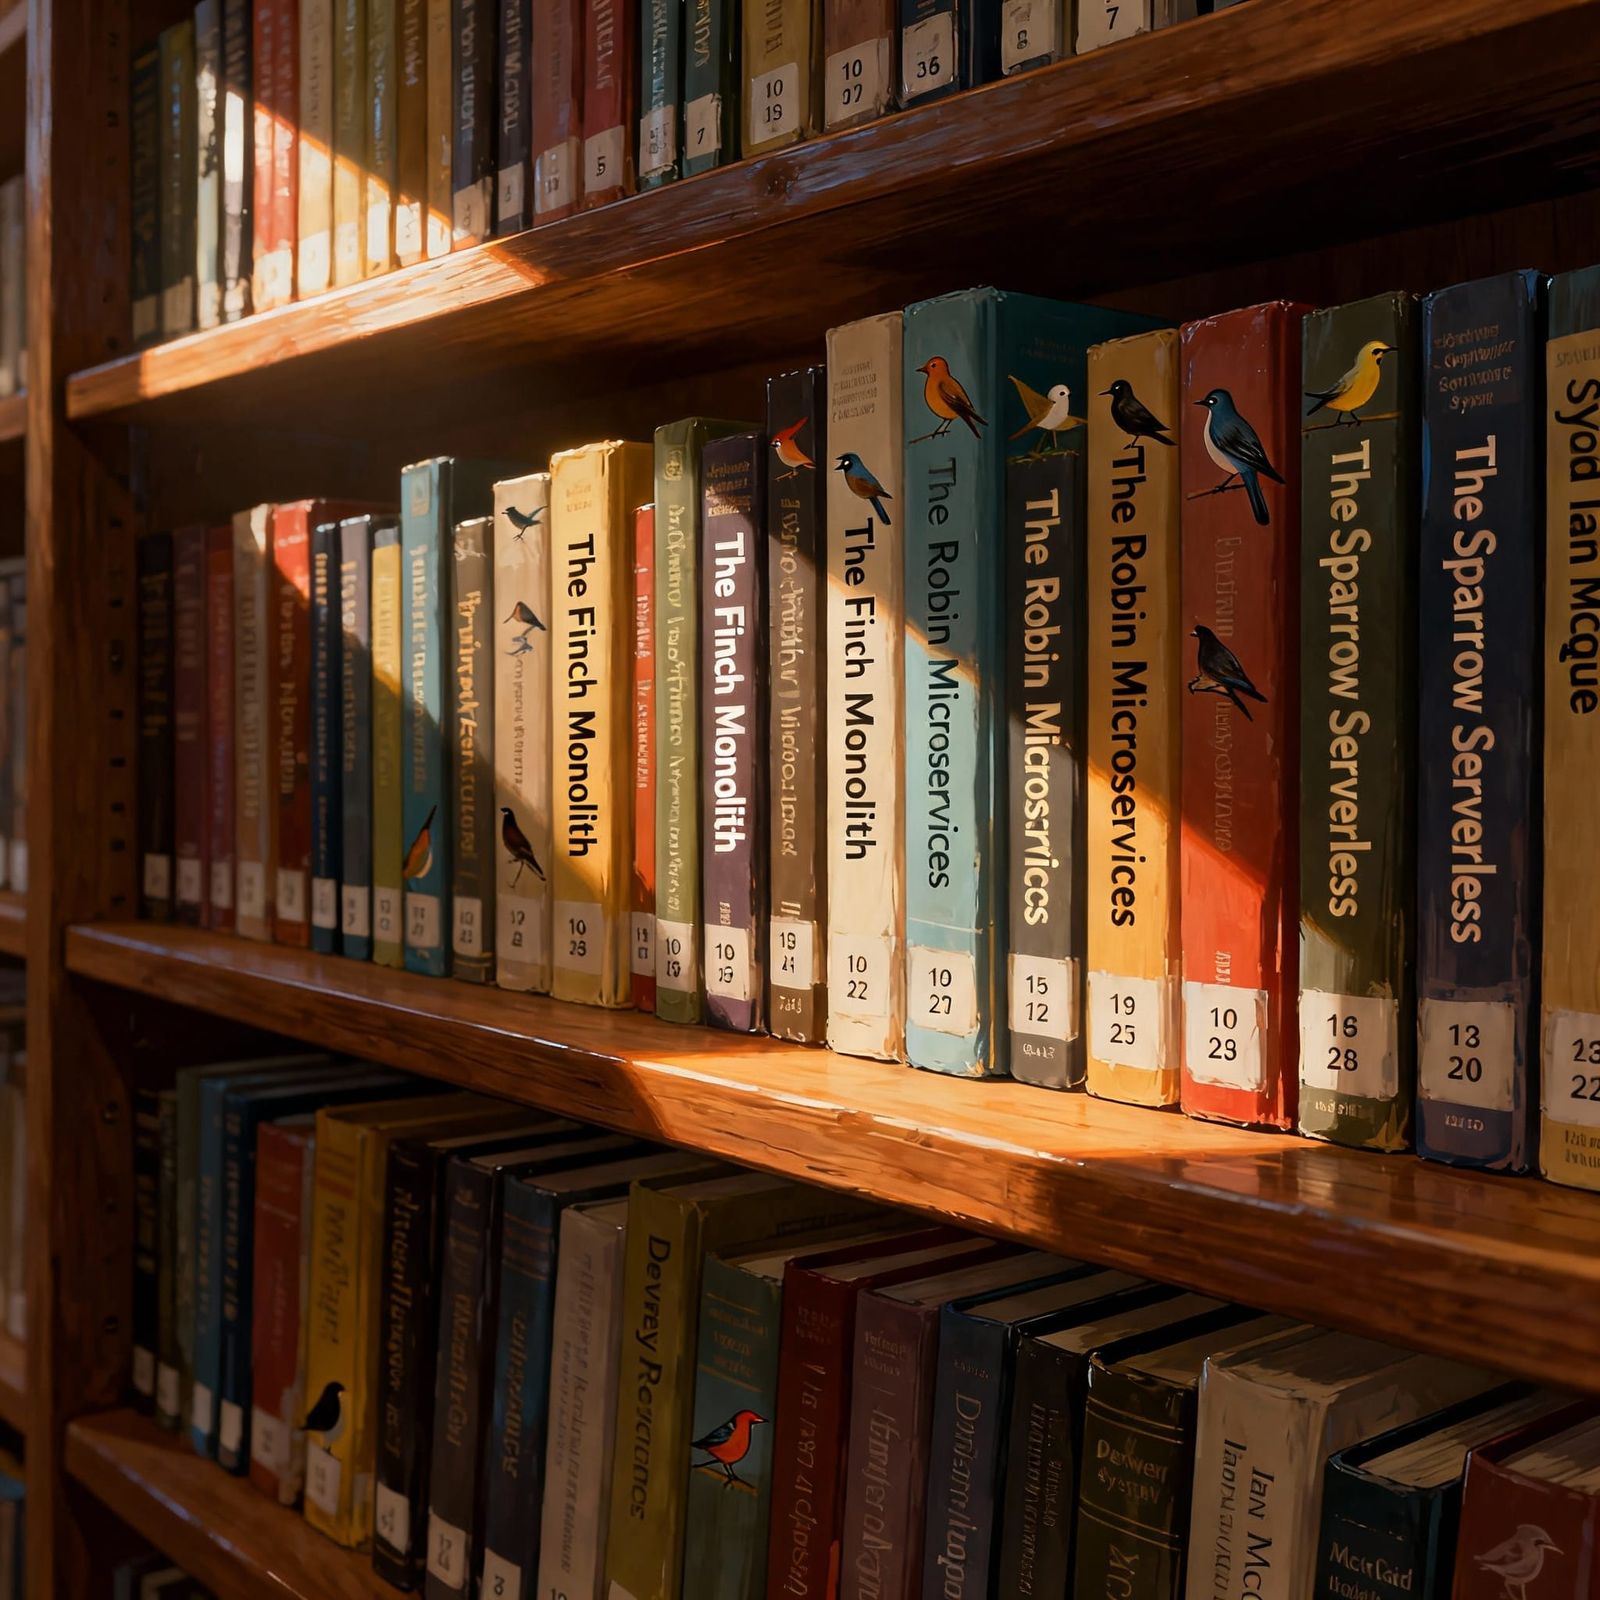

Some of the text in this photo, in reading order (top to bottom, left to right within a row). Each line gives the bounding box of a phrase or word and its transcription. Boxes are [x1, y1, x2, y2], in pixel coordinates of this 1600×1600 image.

[765, 79, 784, 99] 10
[841, 59, 863, 81] 10
[1453, 434, 1498, 522] The
[1024, 488, 1061, 566] The
[568, 533, 596, 598] The
[714, 532, 746, 598] The
[844, 517, 875, 587] The
[1024, 576, 1061, 688] Robin
[1442, 529, 1498, 715] Sparrow
[568, 606, 598, 699] Finch
[714, 606, 745, 695] Finch
[927, 457, 960, 889] The Robin Microservices
[1111, 446, 1148, 927] The Robin Microservices
[1319, 439, 1372, 918] The Sparrow Serverless
[568, 711, 598, 857] Monolith
[714, 705, 747, 853] Monolith
[844, 693, 877, 860] Monolith
[1450, 725, 1498, 944] Serverless
[569, 918, 587, 936] 10
[665, 937, 681, 956] 10
[714, 943, 735, 961] 10
[847, 954, 868, 973] 10
[846, 979, 868, 1001] 22
[928, 967, 952, 987] 10
[1025, 975, 1049, 995] 15
[1025, 1002, 1049, 1023] 12
[1109, 993, 1136, 1016] 19
[1210, 1007, 1238, 1030] 10
[1326, 1013, 1358, 1038] 16
[1109, 1023, 1136, 1045] 25
[1326, 1046, 1359, 1072] 28
[1447, 1055, 1483, 1083] 20
